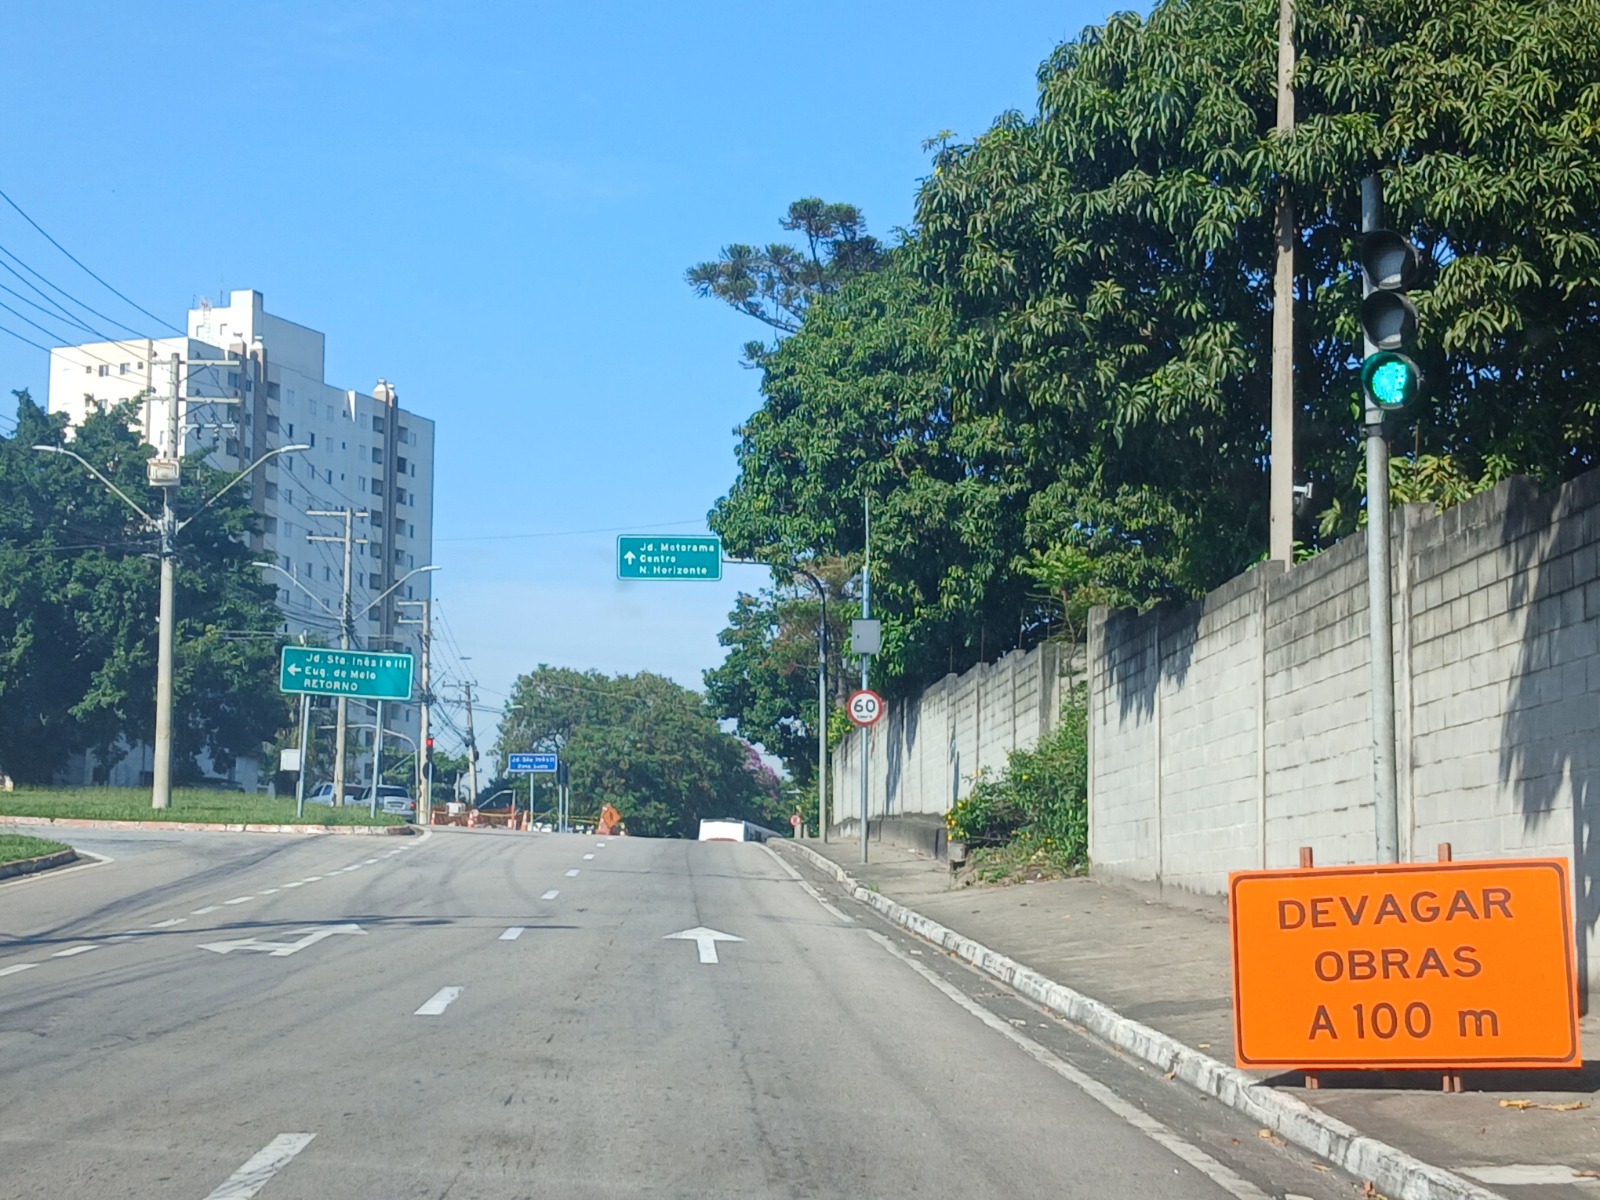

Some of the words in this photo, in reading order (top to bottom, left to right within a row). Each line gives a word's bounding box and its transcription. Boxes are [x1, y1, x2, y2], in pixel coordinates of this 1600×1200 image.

[640, 542, 657, 552] Jd.
[660, 542, 715, 552] Motorama
[639, 554, 676, 563] Centro
[639, 565, 650, 574] N.
[653, 565, 707, 575] Horizonte
[306, 653, 323, 663] Jd.
[327, 655, 349, 665] Sta.
[352, 656, 376, 667] Inês
[304, 666, 329, 678] Eug.
[333, 669, 346, 678] de
[350, 670, 376, 680] Melo
[303, 678, 358, 691] RETORNO
[853, 698, 875, 713] 60
[1277, 888, 1514, 930] DEVAGAR
[1314, 945, 1482, 982] OBRAS
[1308, 1004, 1339, 1040] A
[1353, 1001, 1431, 1039] 100
[1458, 1008, 1499, 1037] m
